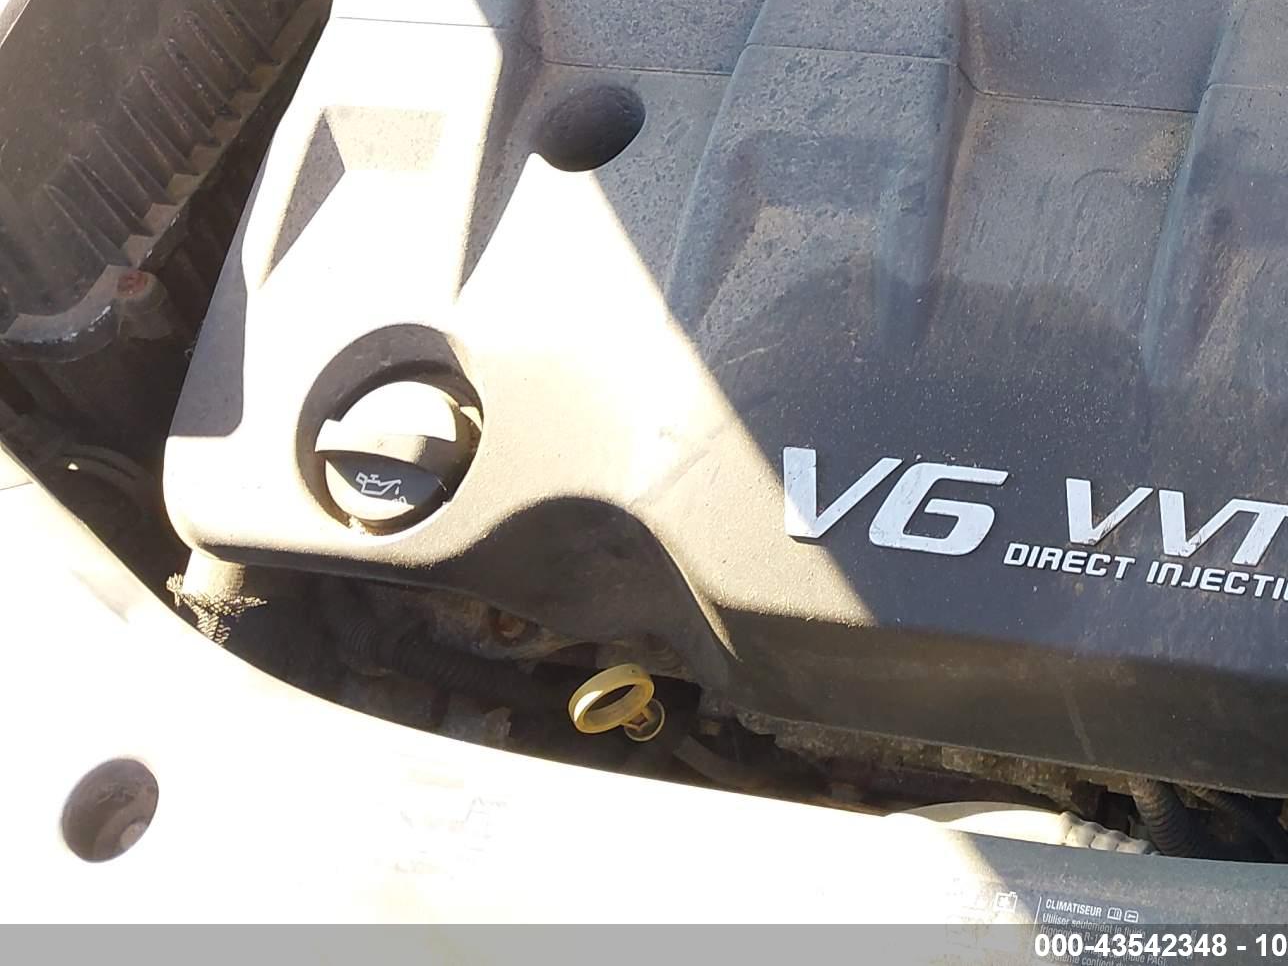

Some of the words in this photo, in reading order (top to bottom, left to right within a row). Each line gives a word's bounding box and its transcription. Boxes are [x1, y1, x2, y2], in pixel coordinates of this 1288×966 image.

[782, 446, 1009, 556] V6
[1003, 541, 1136, 581] DIRECT
[1045, 898, 1102, 916] CLIMATISEUR
